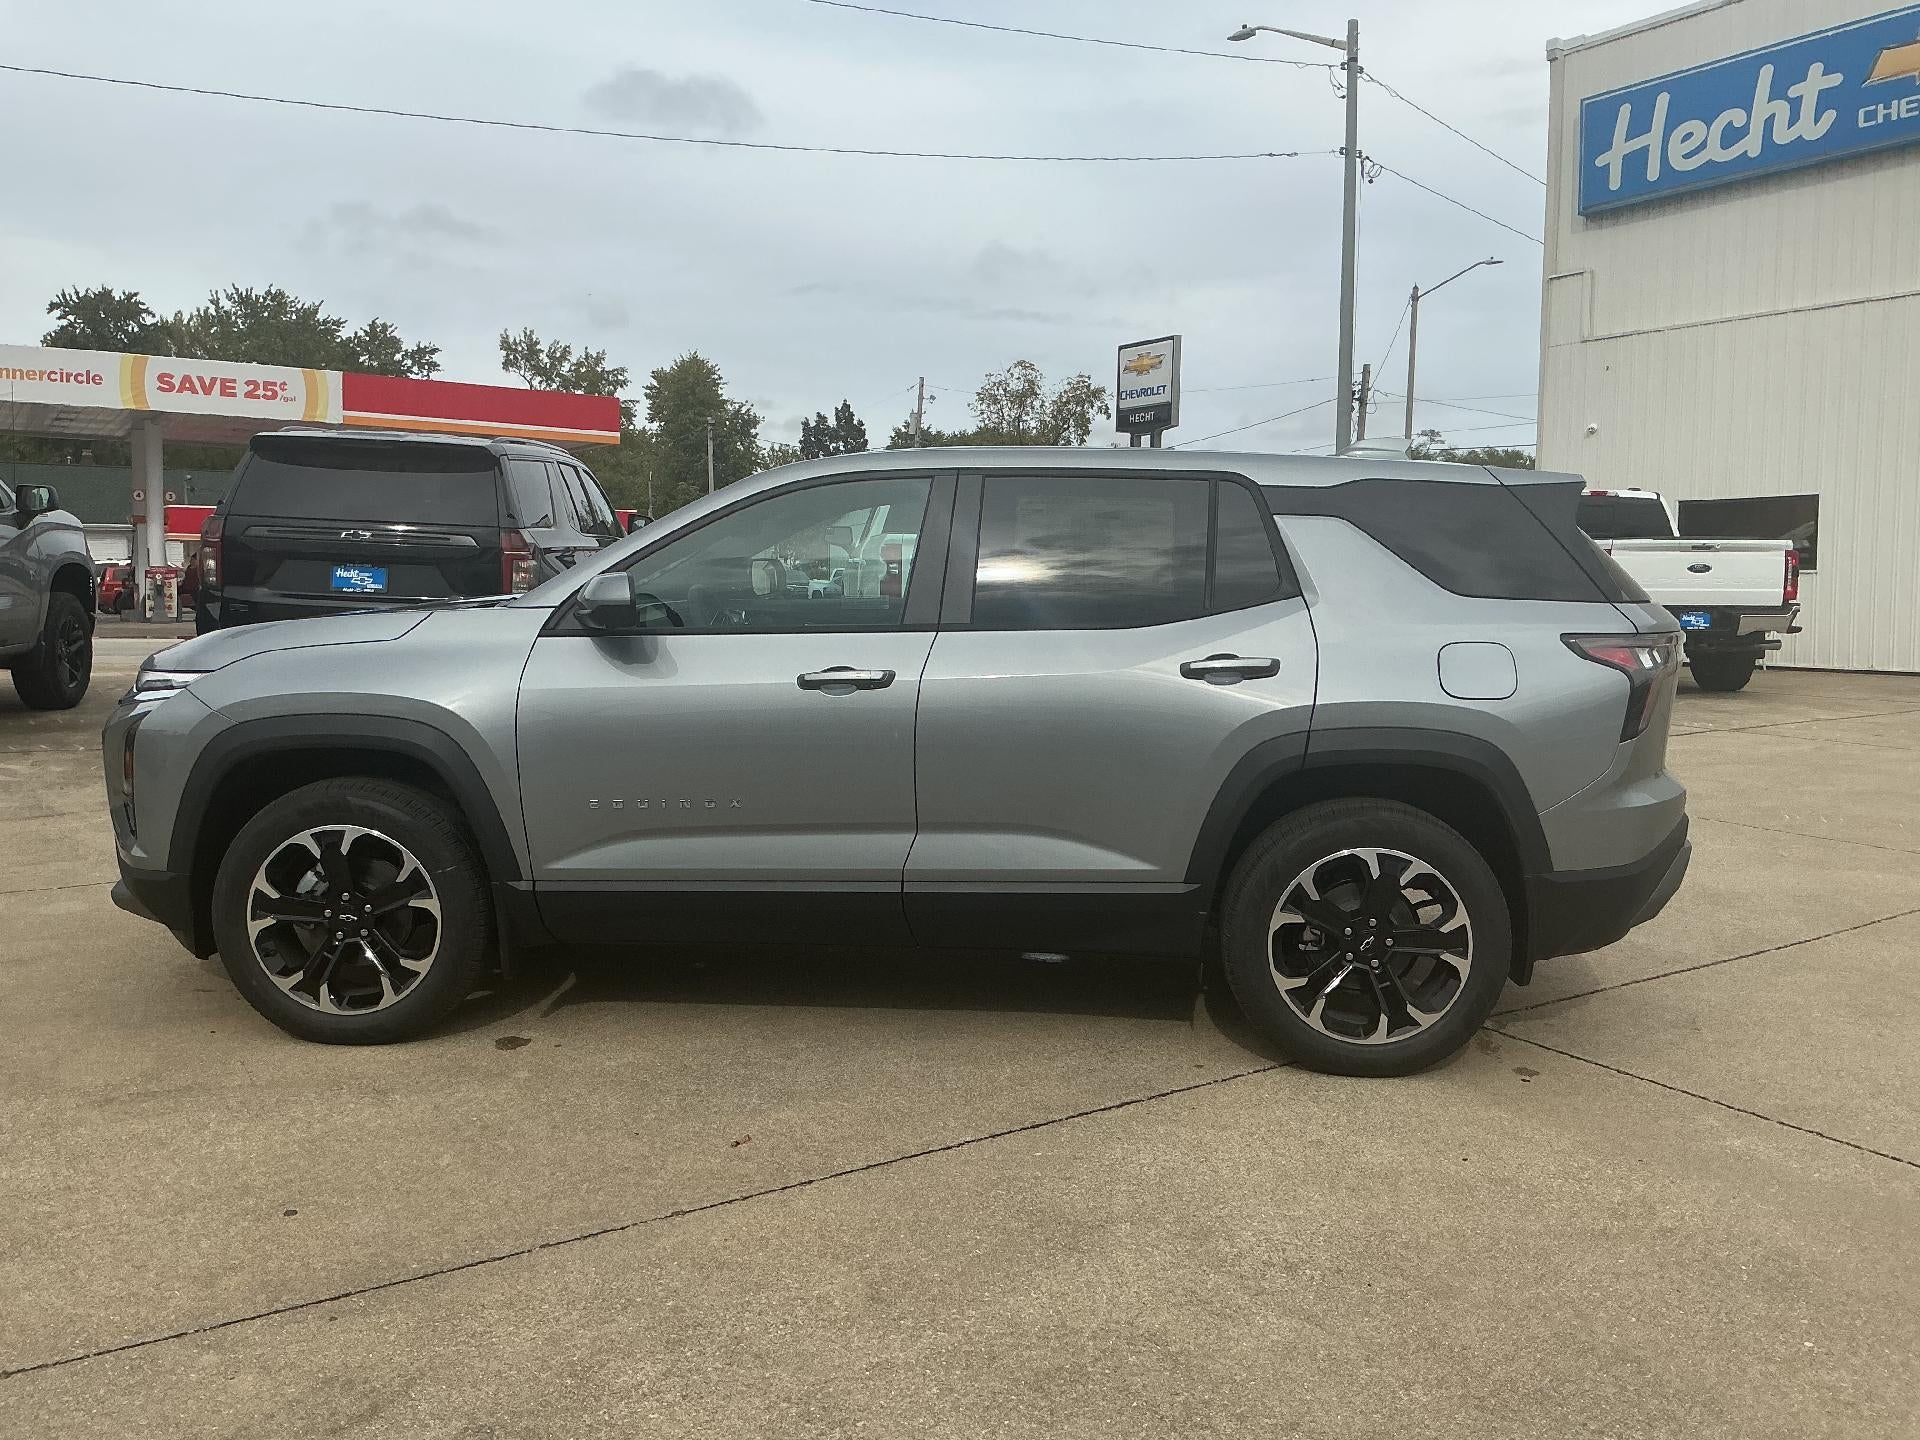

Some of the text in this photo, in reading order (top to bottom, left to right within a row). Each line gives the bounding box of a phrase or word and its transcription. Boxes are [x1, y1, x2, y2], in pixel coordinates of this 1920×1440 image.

[1594, 61, 1844, 191] Hecht
[156, 371, 238, 398] SAVE
[1120, 384, 1168, 401] CHEVROLET
[1129, 411, 1155, 423] HECHT
[335, 567, 360, 578] Hecht
[588, 799, 743, 809] EQUINOX
